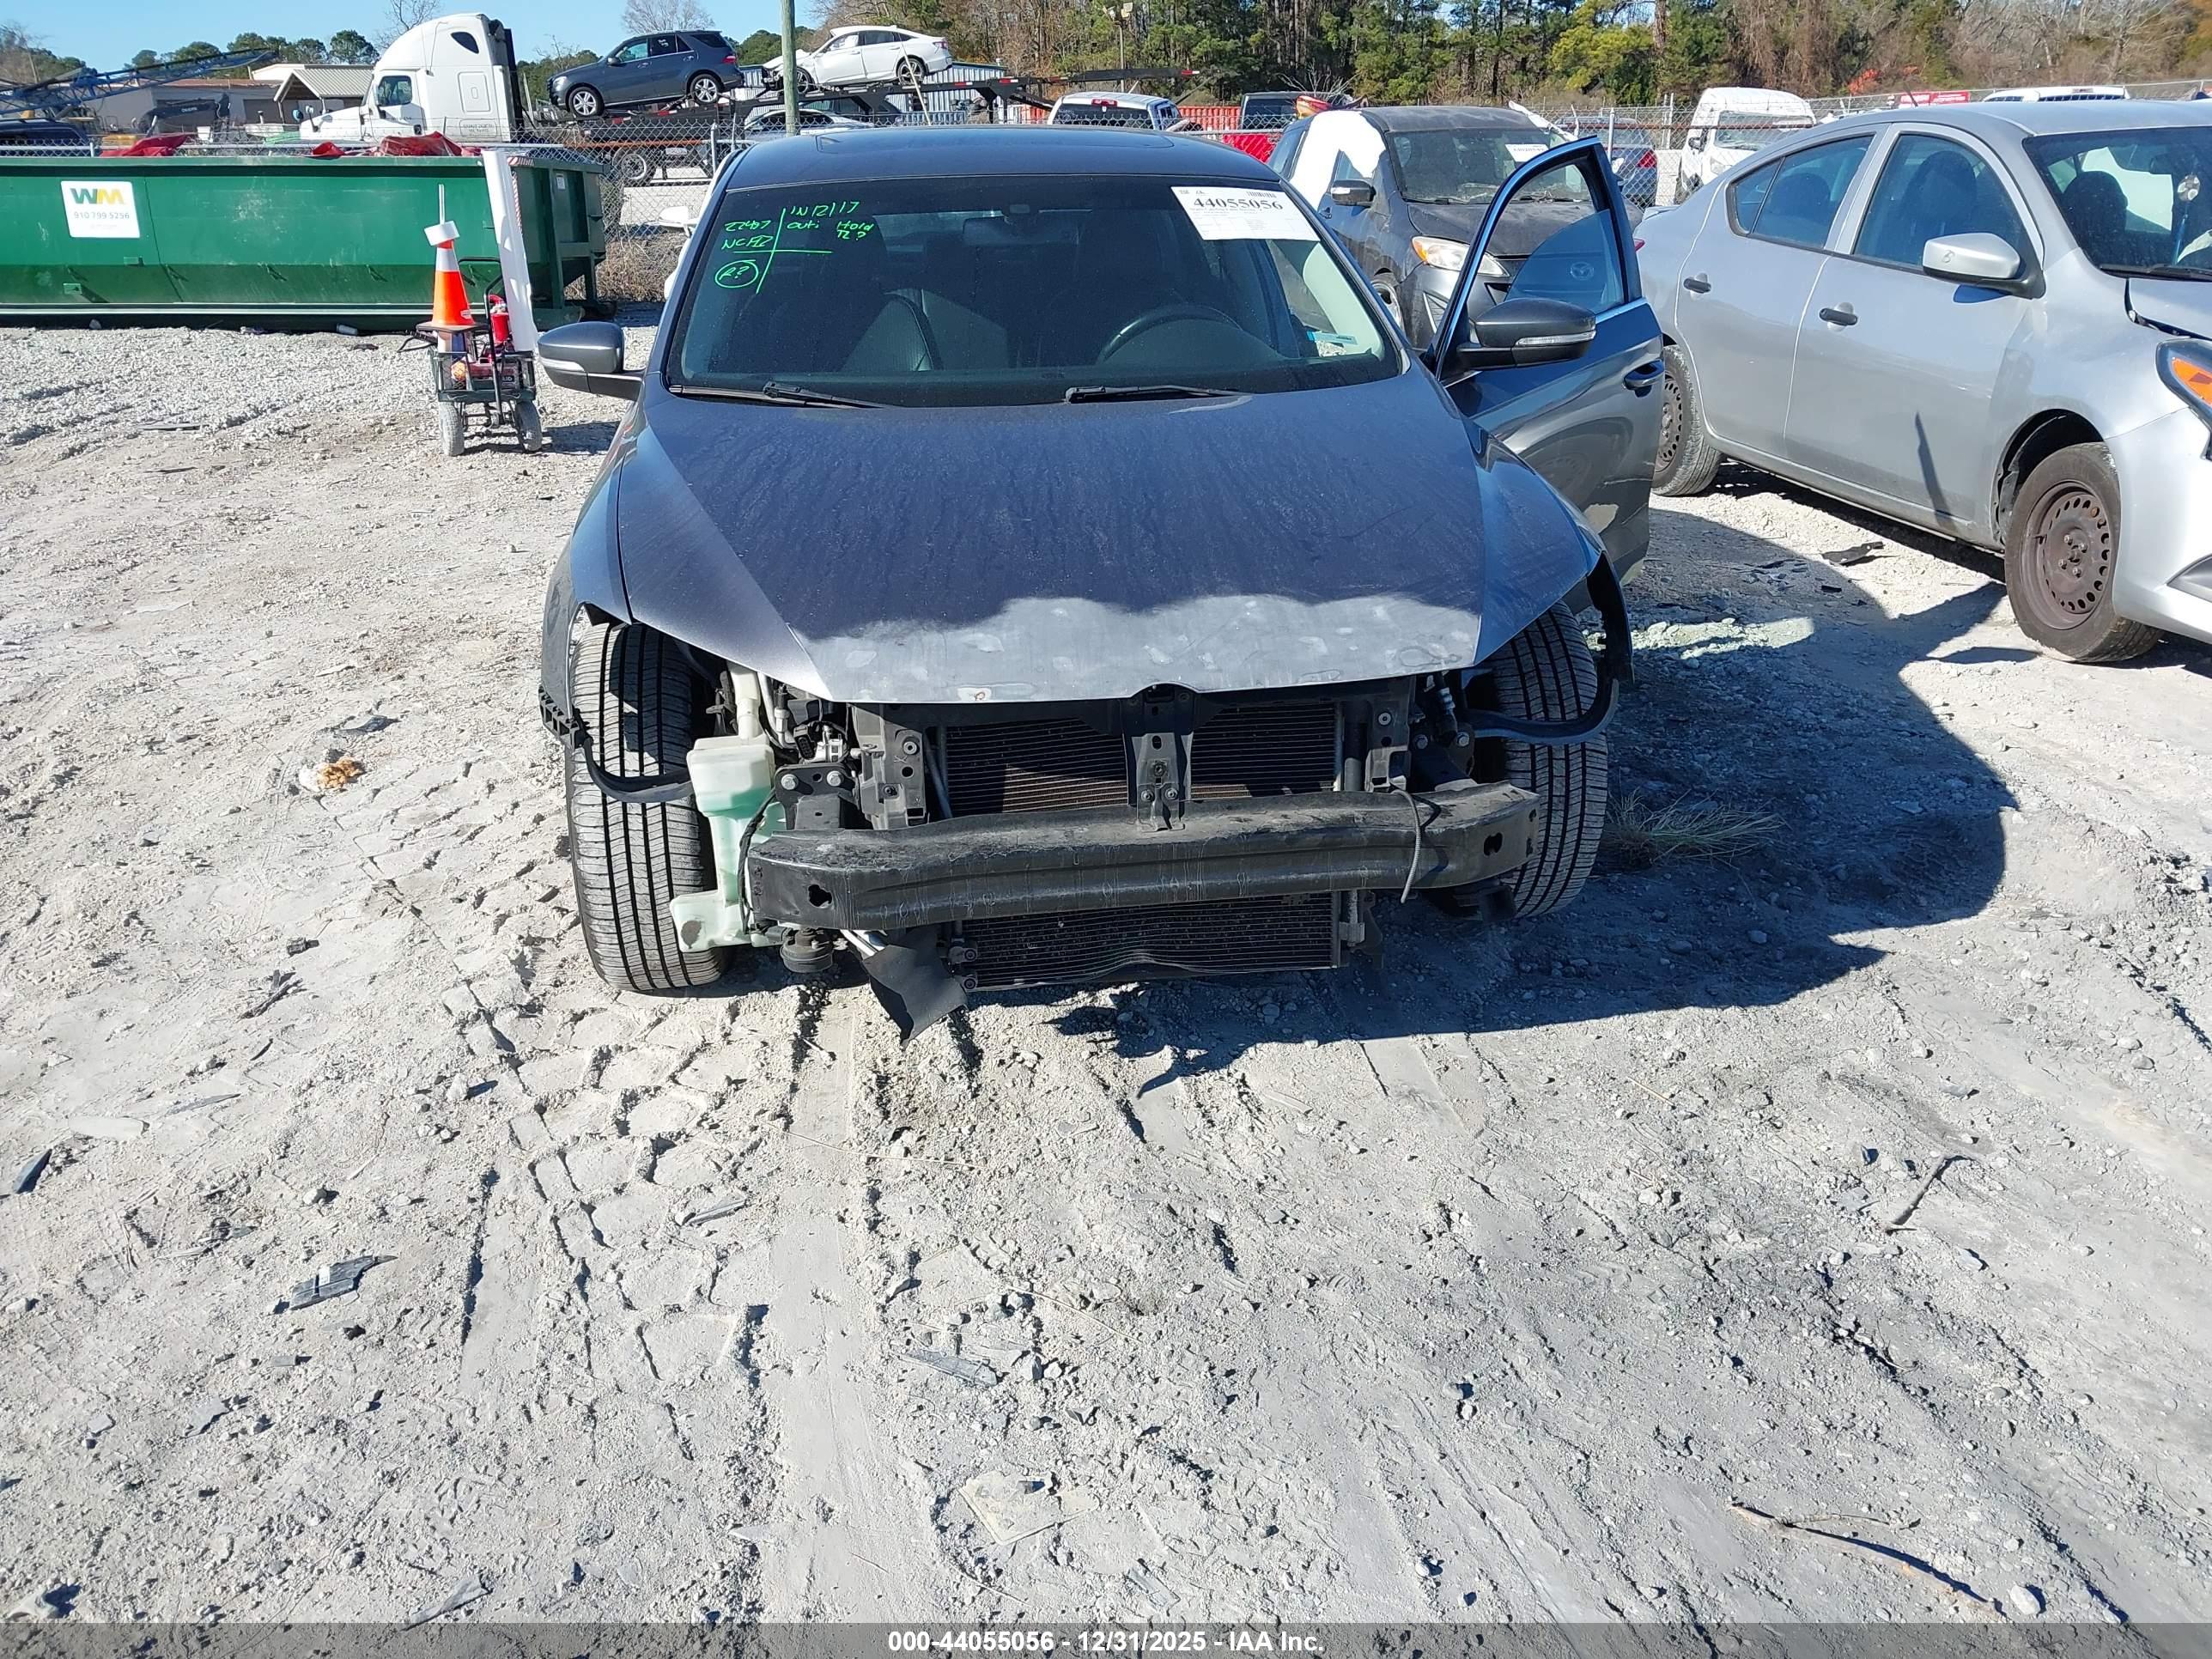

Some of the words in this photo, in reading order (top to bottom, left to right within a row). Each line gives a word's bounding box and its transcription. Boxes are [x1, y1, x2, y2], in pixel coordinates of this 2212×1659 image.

[70, 188, 125, 204] WM
[1194, 198, 1284, 210] 44055056
[91, 211, 107, 220] 799
[836, 220, 874, 231] Hold
